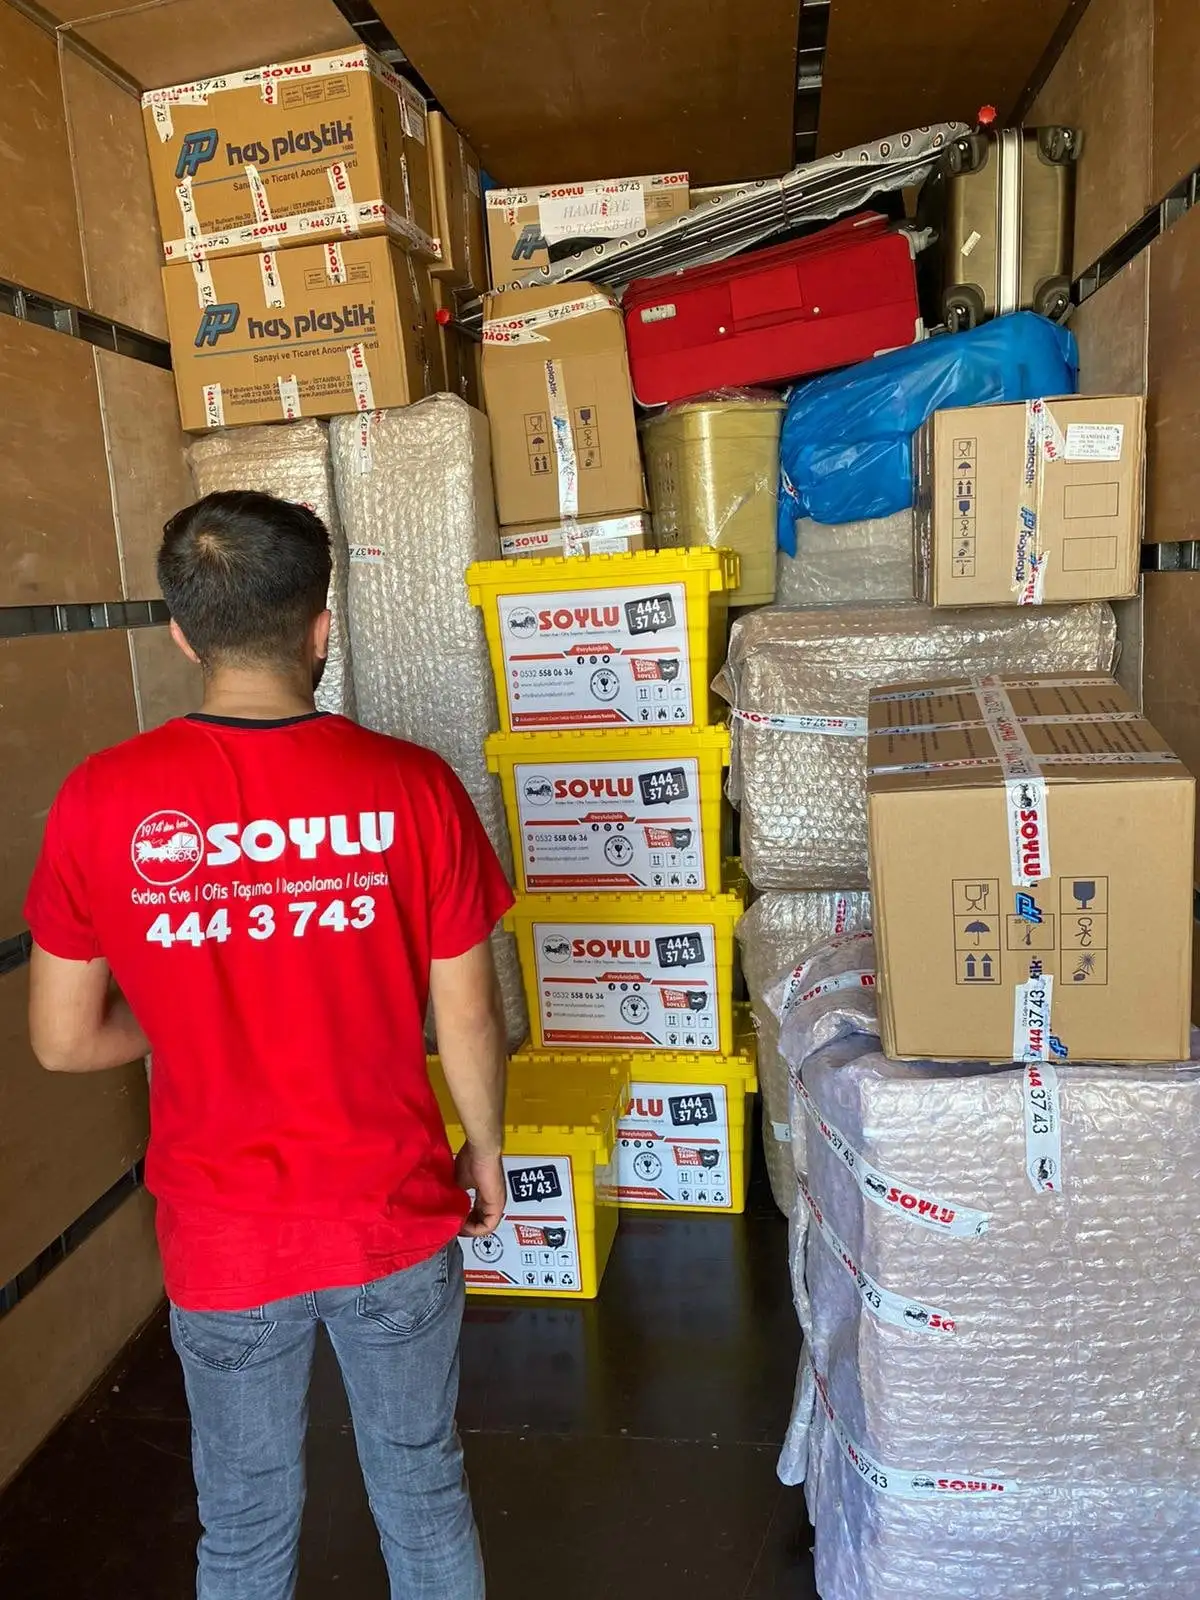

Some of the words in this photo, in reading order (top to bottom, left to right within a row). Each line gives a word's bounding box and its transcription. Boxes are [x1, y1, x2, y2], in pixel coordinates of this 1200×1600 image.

[262, 63, 312, 79] SOYLU
[226, 140, 270, 167] has
[272, 118, 354, 162] plastik
[551, 186, 584, 198] SOYLU
[252, 223, 288, 237] SOYLU
[247, 316, 291, 340] has
[294, 303, 376, 338] plastik
[252, 351, 280, 364] Sanayi
[281, 352, 291, 360] ve
[292, 347, 320, 359] Ticaret
[515, 534, 549, 547] SOYLU
[636, 598, 661, 615] 444
[538, 605, 620, 631] SOYLU
[635, 615, 648, 630] 37
[651, 610, 668, 626] 43
[519, 669, 538, 678] 0532
[538, 668, 552, 677] 558
[553, 667, 563, 676] 06
[563, 667, 573, 676] 36
[555, 777, 634, 799] SOYLU
[650, 772, 674, 788] 444
[649, 787, 662, 801] 37
[665, 783, 680, 797] 43
[206, 811, 395, 866] SOYLU
[535, 834, 553, 843] 0532
[554, 834, 567, 842] 558
[568, 834, 578, 842] 06
[578, 833, 588, 842] 36
[1020, 809, 1042, 878] SOYLU
[131, 888, 166, 905] Evden
[169, 886, 191, 902] Eve
[202, 883, 229, 901] Ofis
[232, 880, 273, 902] Taşıma
[146, 907, 232, 948] 444
[247, 903, 276, 941] 3
[288, 895, 376, 937] 743
[572, 938, 651, 959] SOYLU
[666, 936, 690, 950] 444
[665, 950, 678, 964] 37
[681, 947, 697, 961] 43
[552, 991, 570, 999] 0532
[570, 992, 584, 1000] 558
[585, 992, 595, 1000] 06
[595, 993, 605, 1001] 36
[679, 1096, 703, 1110] 444
[678, 1110, 691, 1122] 37
[694, 1107, 709, 1120] 43
[520, 1169, 546, 1184] 444
[518, 1184, 533, 1198] 37
[536, 1180, 553, 1195] 43
[886, 1187, 956, 1224] SOYLU
